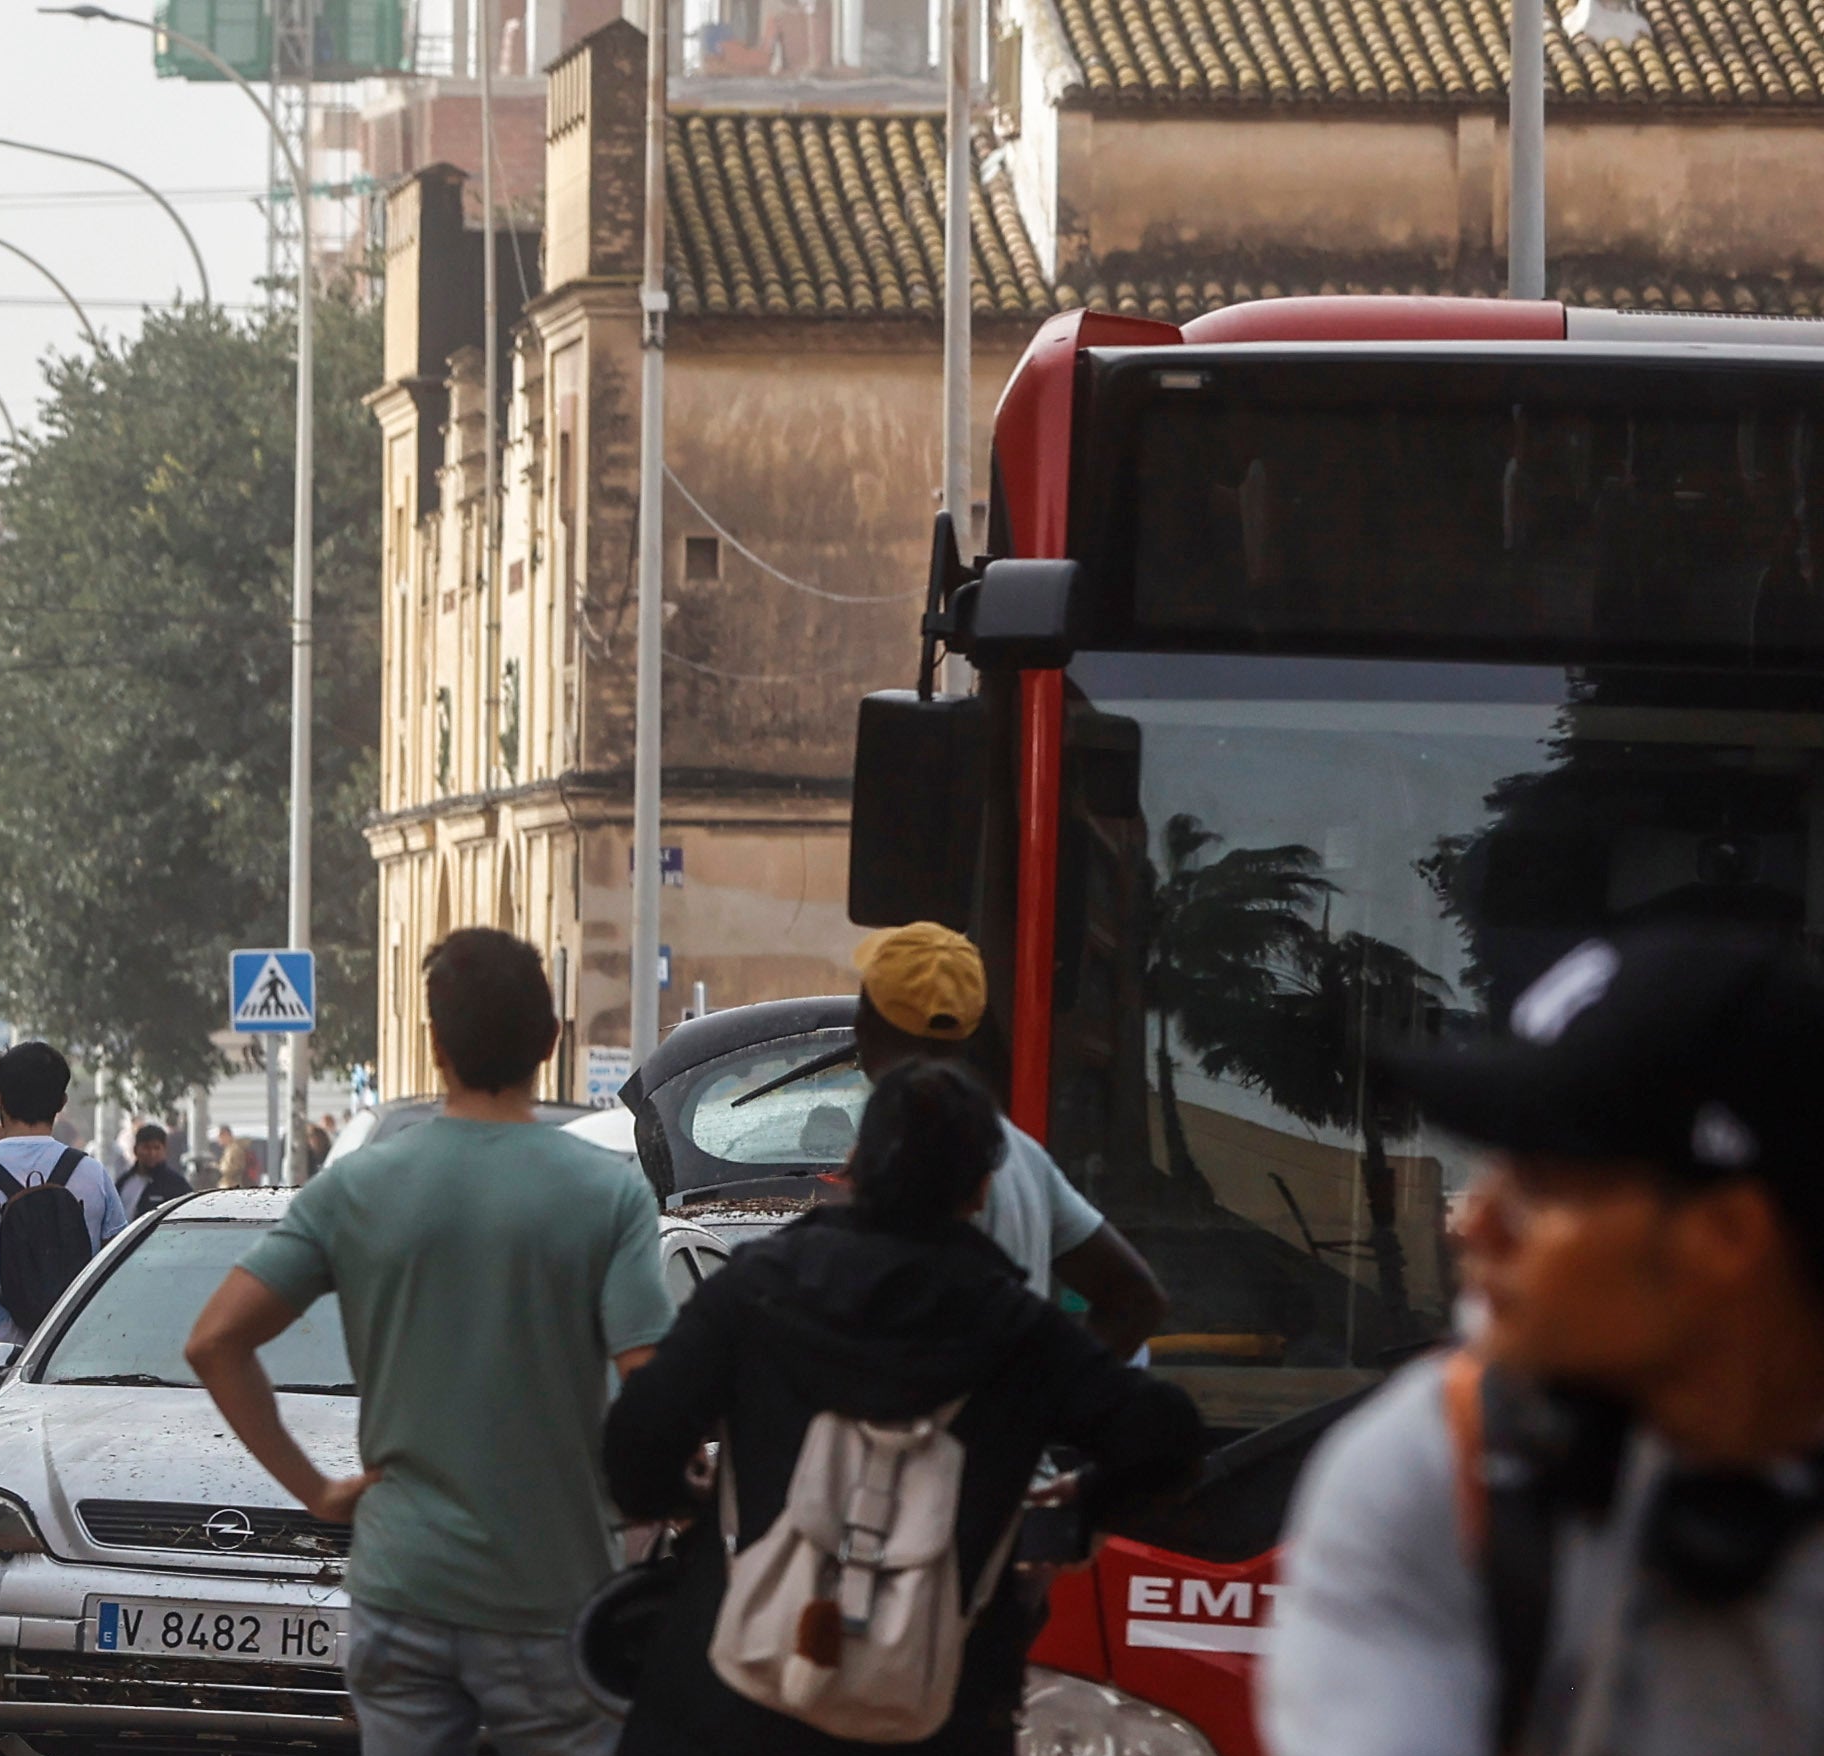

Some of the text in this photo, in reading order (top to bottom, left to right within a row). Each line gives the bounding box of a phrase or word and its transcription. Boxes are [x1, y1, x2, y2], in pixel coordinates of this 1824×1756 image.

[122, 1609, 330, 1657] V 8482 HC
